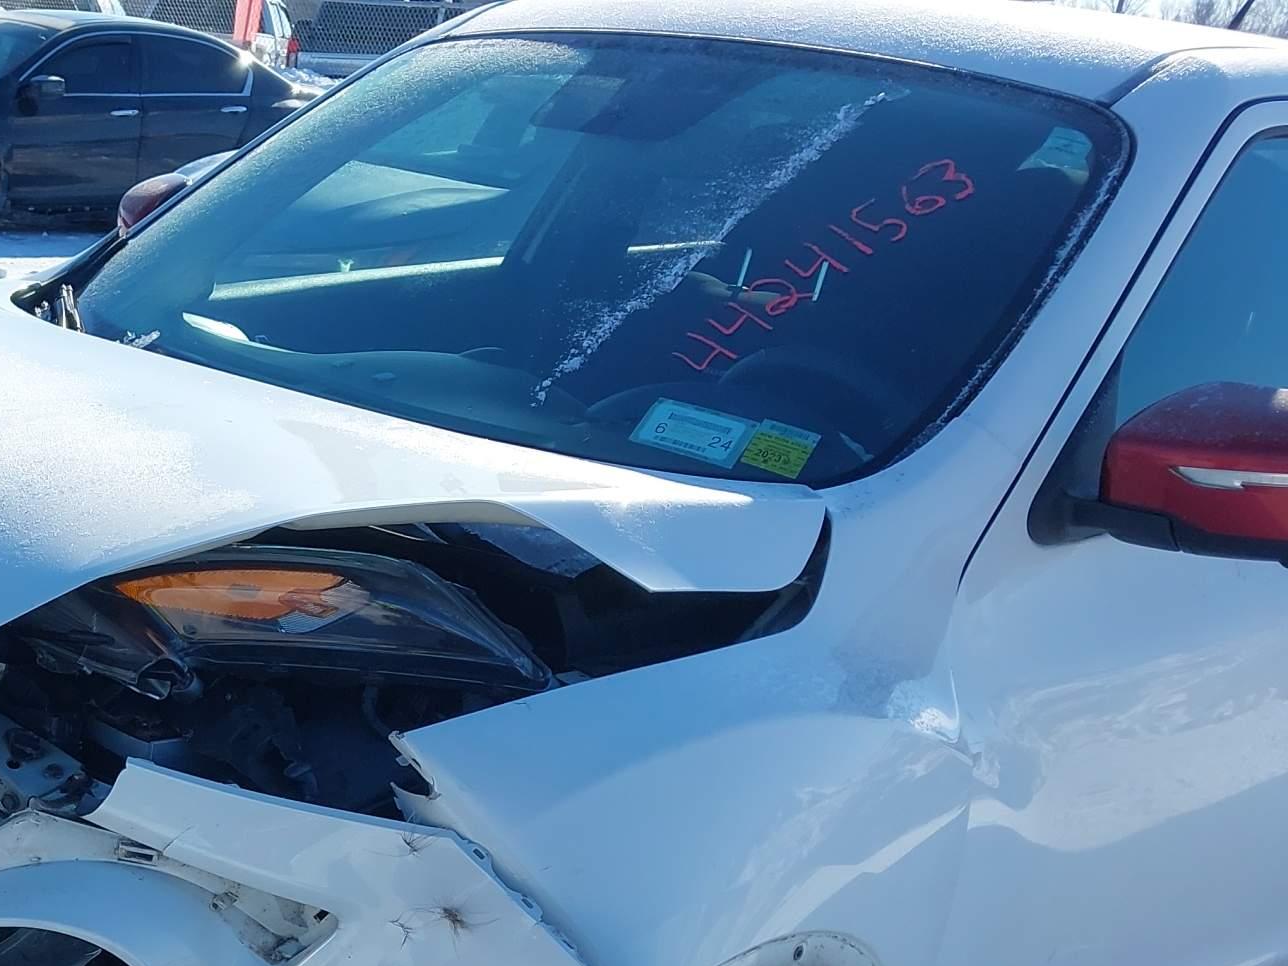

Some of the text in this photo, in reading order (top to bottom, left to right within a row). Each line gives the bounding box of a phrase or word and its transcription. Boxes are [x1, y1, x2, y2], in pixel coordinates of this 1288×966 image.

[671, 158, 975, 371] 44241563
[654, 422, 668, 434] 6
[707, 436, 733, 452] 24
